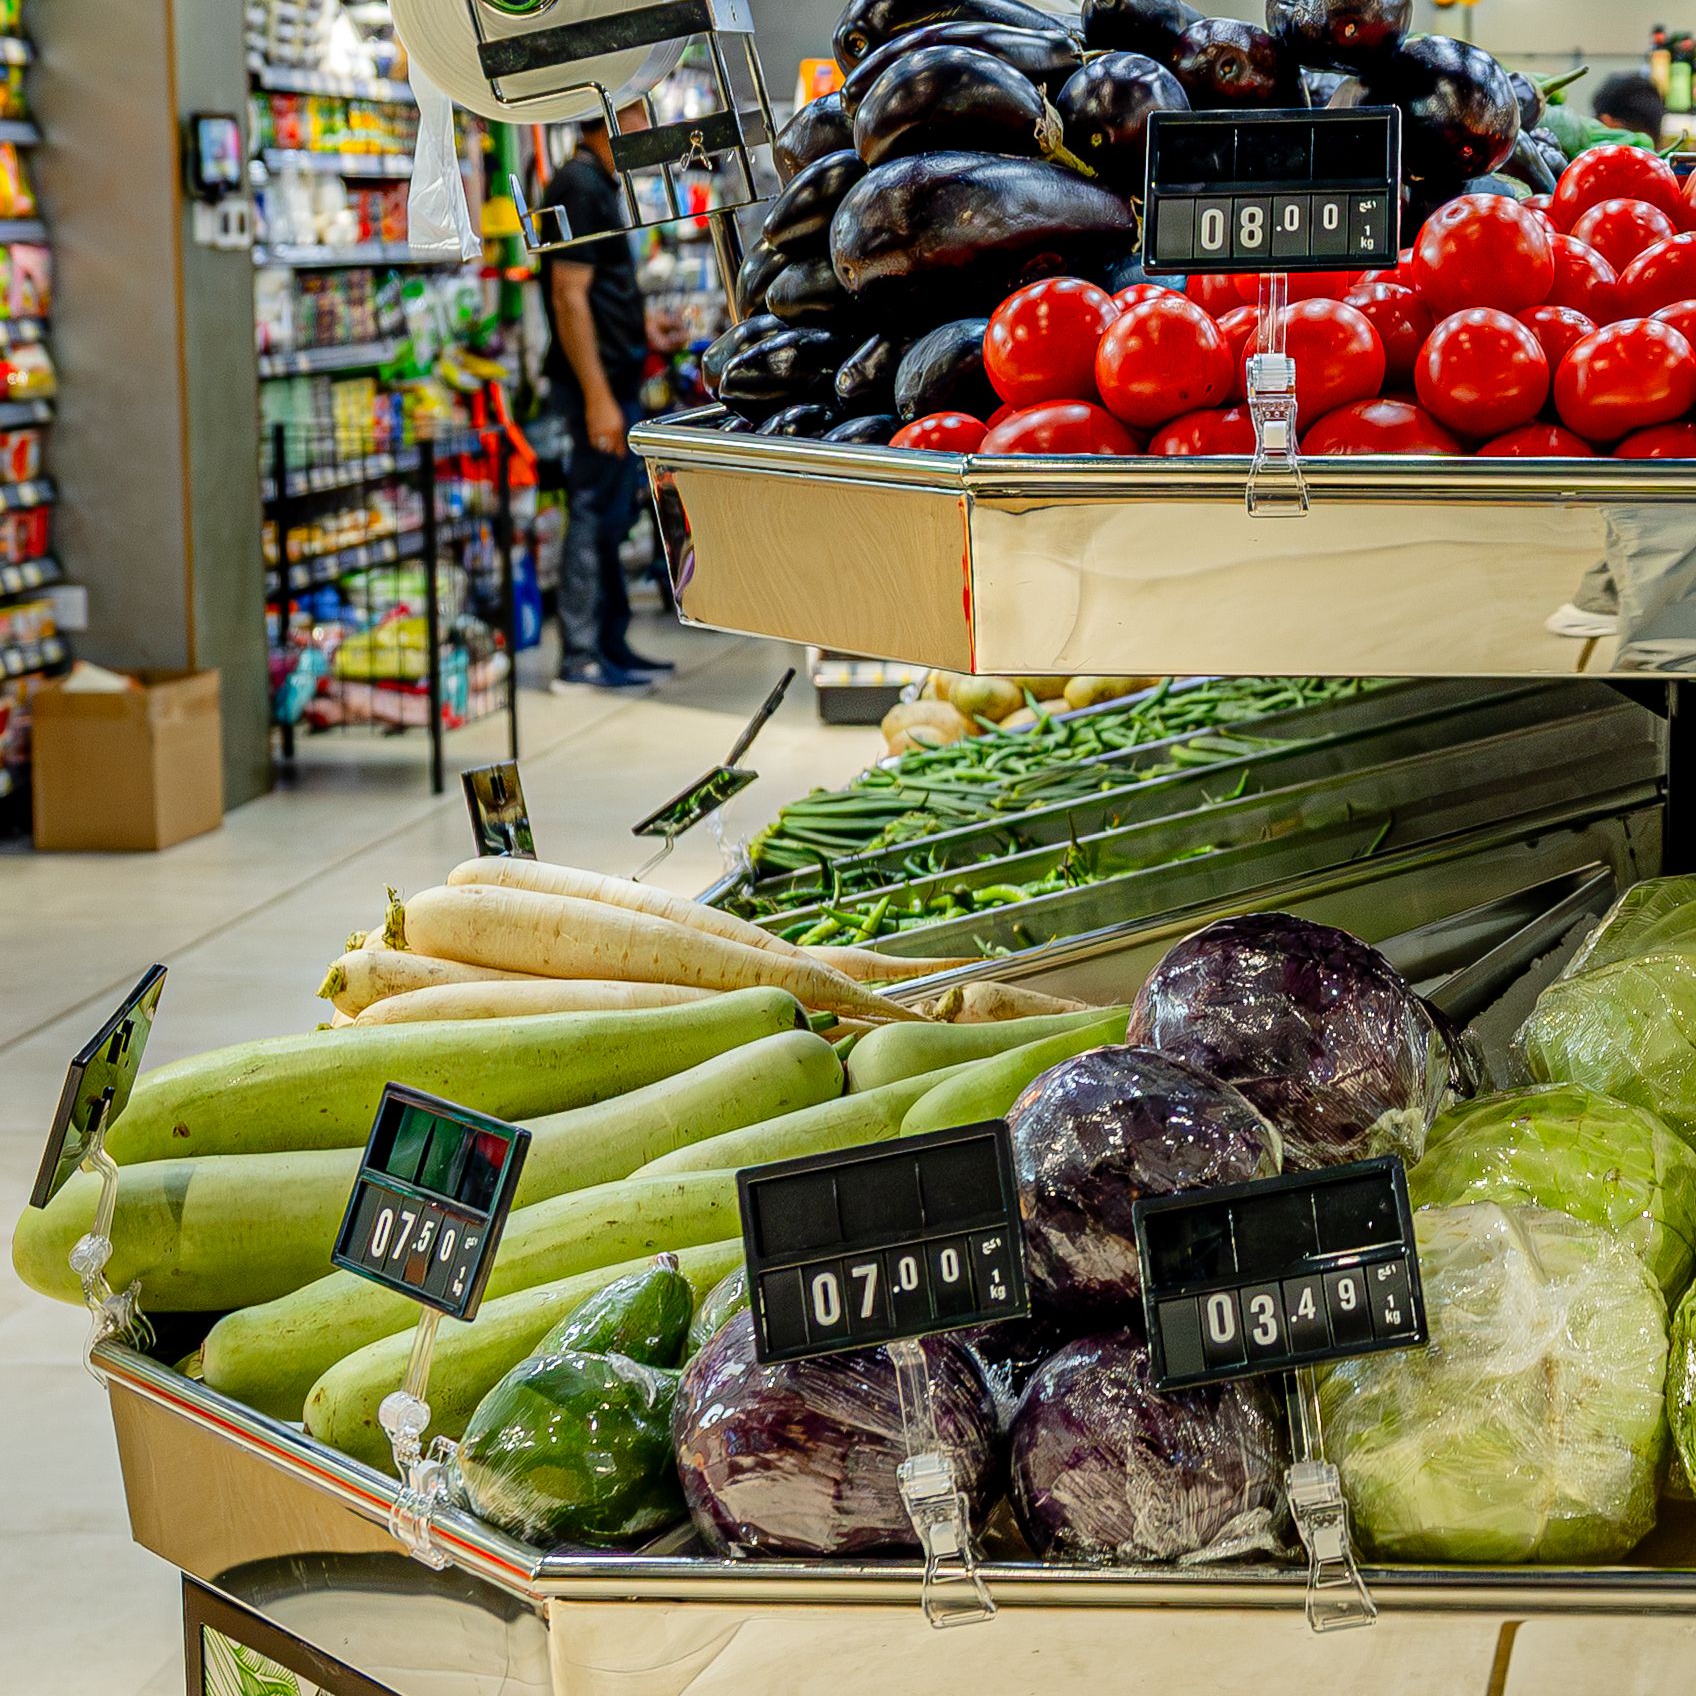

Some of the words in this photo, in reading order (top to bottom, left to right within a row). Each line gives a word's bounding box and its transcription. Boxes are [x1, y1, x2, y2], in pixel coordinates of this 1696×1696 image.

[1200, 203, 1339, 251] 08.00
[1363, 225, 1371, 236] 1
[1360, 236, 1374, 250] kg
[371, 1208, 456, 1262] 07.50
[990, 1268, 1000, 1283] 1
[811, 1248, 960, 1326] 07.00
[989, 1283, 1007, 1300] kg
[1386, 1294, 1395, 1309] 1
[1206, 1278, 1357, 1346] 03.49
[1384, 1308, 1401, 1325] kg
